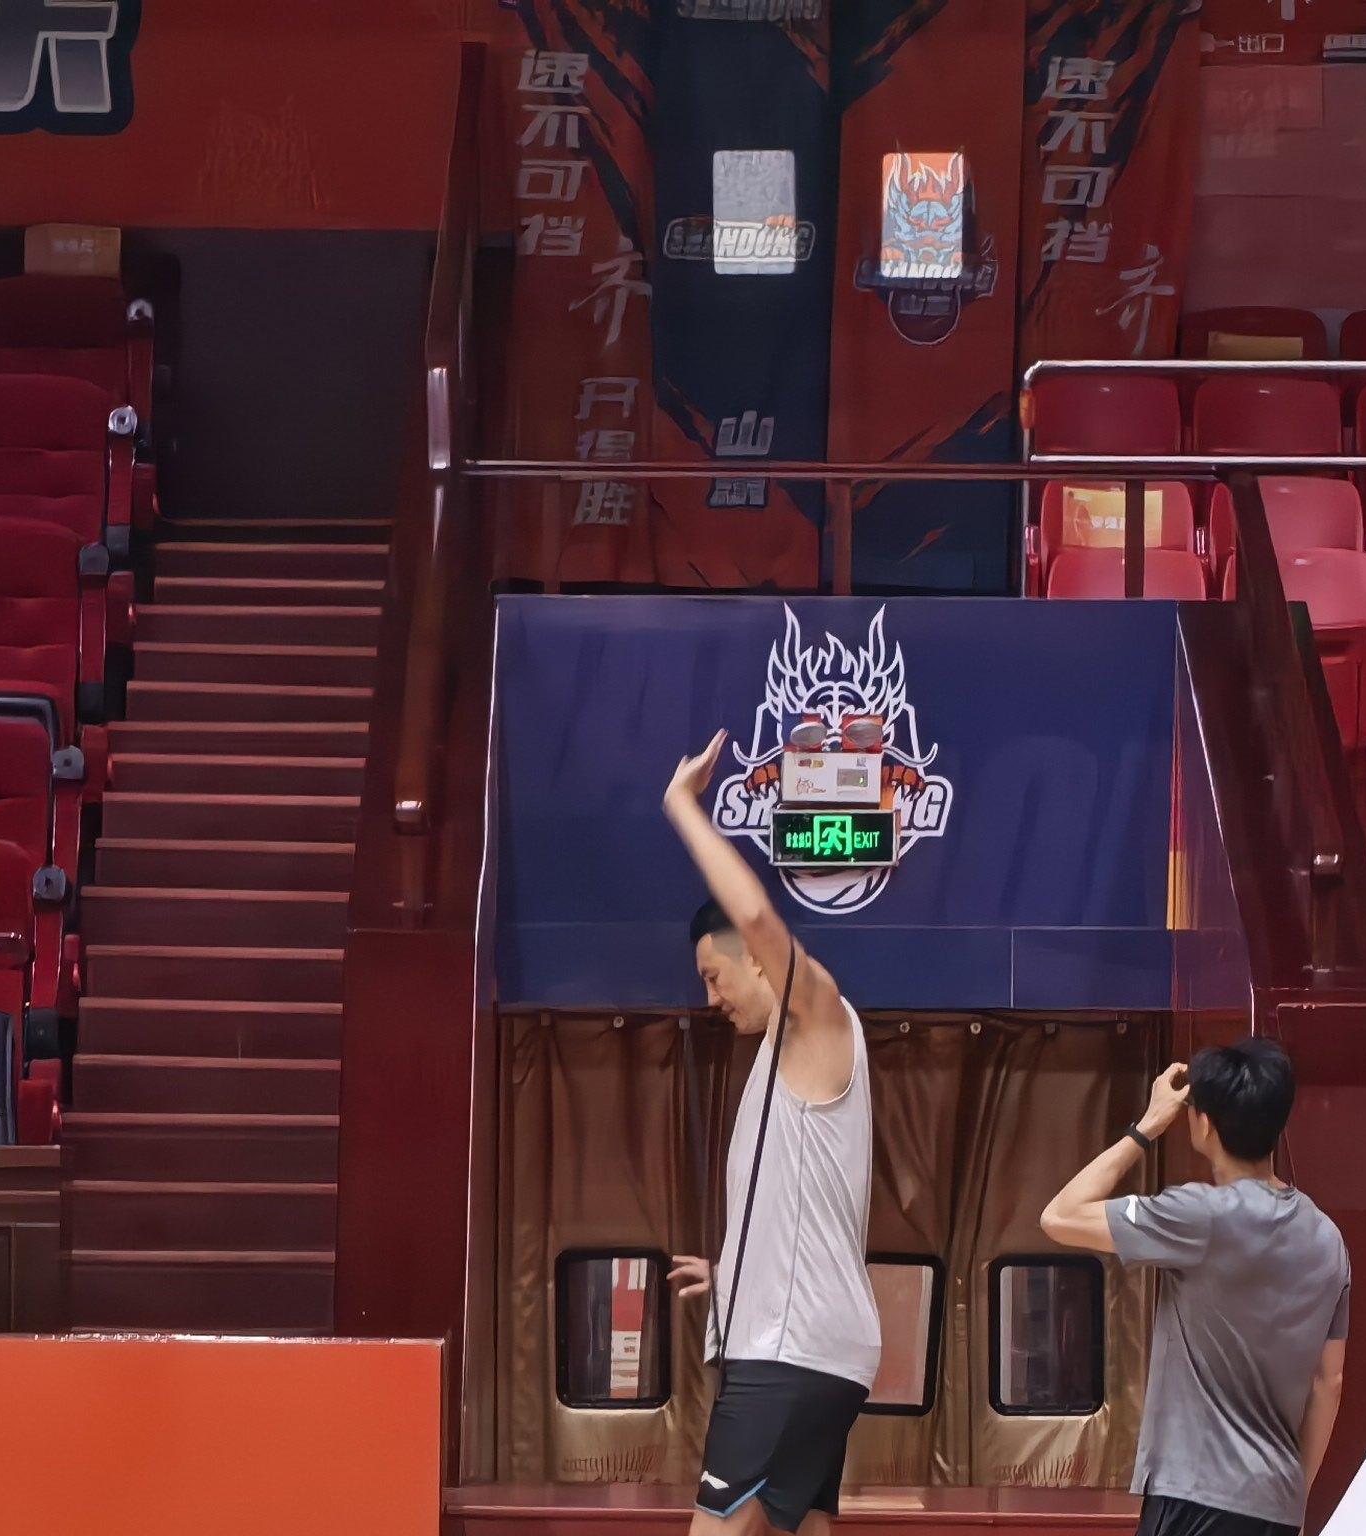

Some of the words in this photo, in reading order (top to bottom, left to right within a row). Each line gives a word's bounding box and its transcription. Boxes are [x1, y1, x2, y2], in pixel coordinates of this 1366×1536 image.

[517, 48, 591, 257] 速不可挡
[1040, 55, 1117, 263] 速不可挡
[722, 782, 945, 830] SHNG
[853, 830, 881, 849] EXIT
